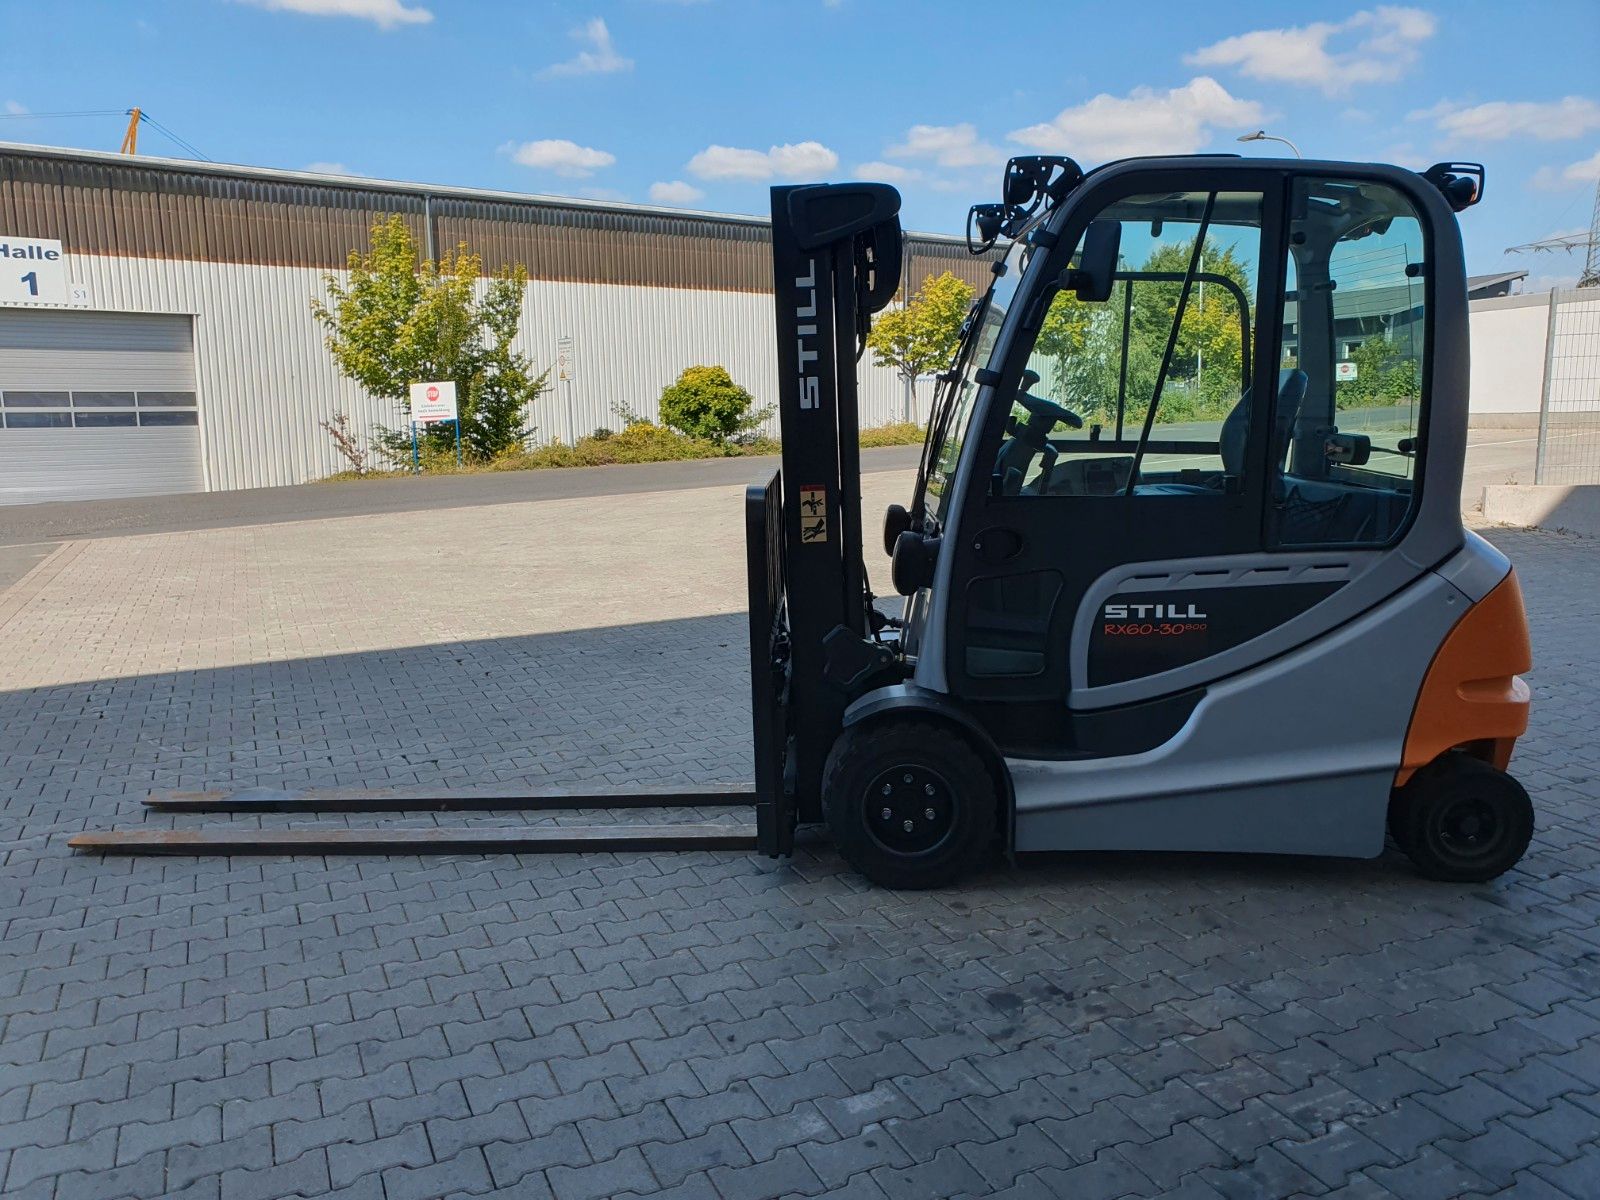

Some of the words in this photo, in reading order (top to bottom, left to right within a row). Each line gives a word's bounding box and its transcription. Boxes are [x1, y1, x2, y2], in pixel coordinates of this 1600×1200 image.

[0, 244, 59, 260] Halle
[21, 272, 38, 296] 1
[796, 259, 820, 409] STILL
[1105, 604, 1207, 618] STILL
